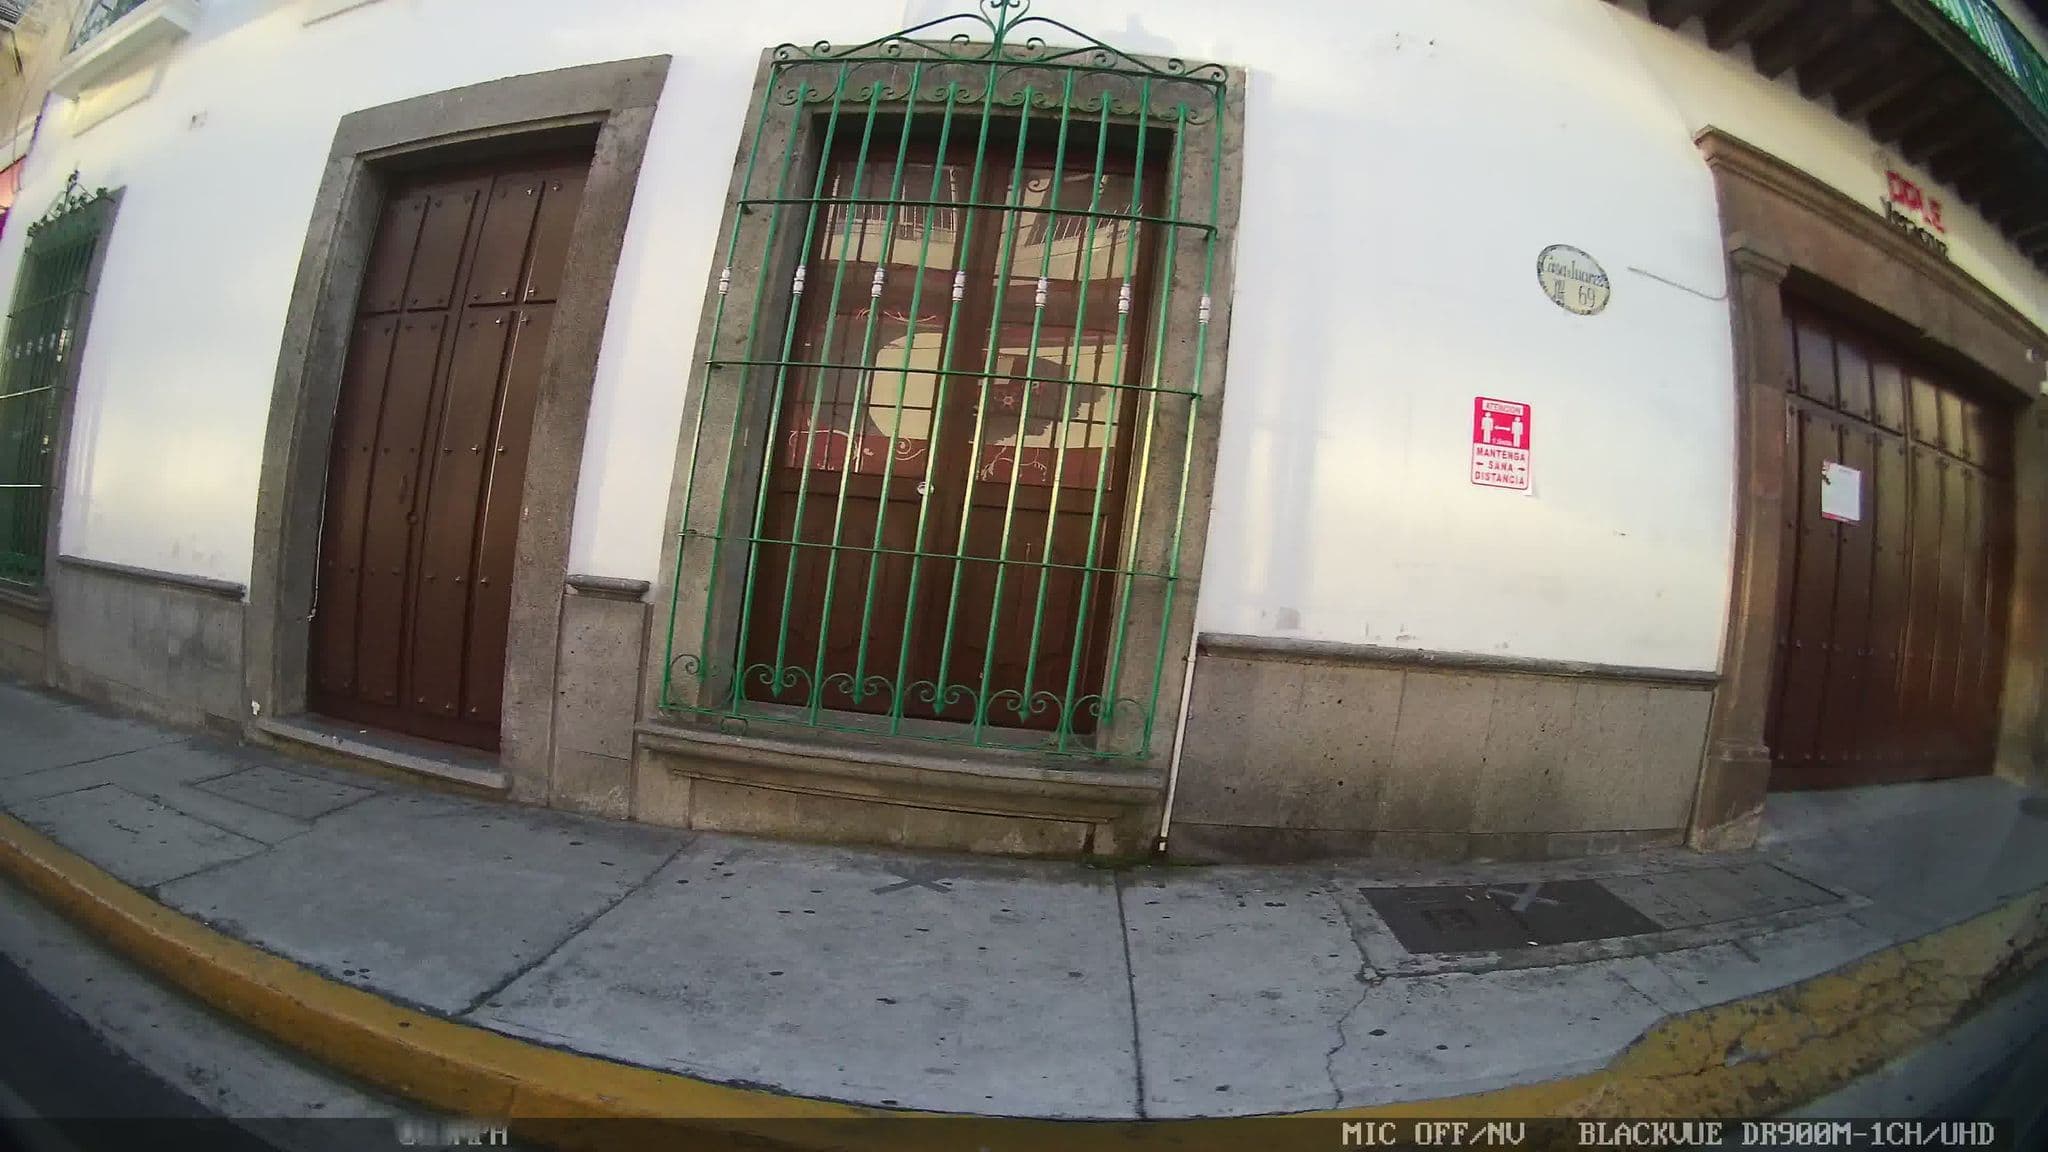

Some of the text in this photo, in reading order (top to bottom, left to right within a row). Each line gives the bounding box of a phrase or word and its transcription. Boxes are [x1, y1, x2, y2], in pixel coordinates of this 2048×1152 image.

[1578, 285, 1596, 308] 69
[1476, 447, 1526, 461] MANTENGA
[1488, 460, 1513, 472] SANA
[1475, 471, 1524, 484] DISTANCIA
